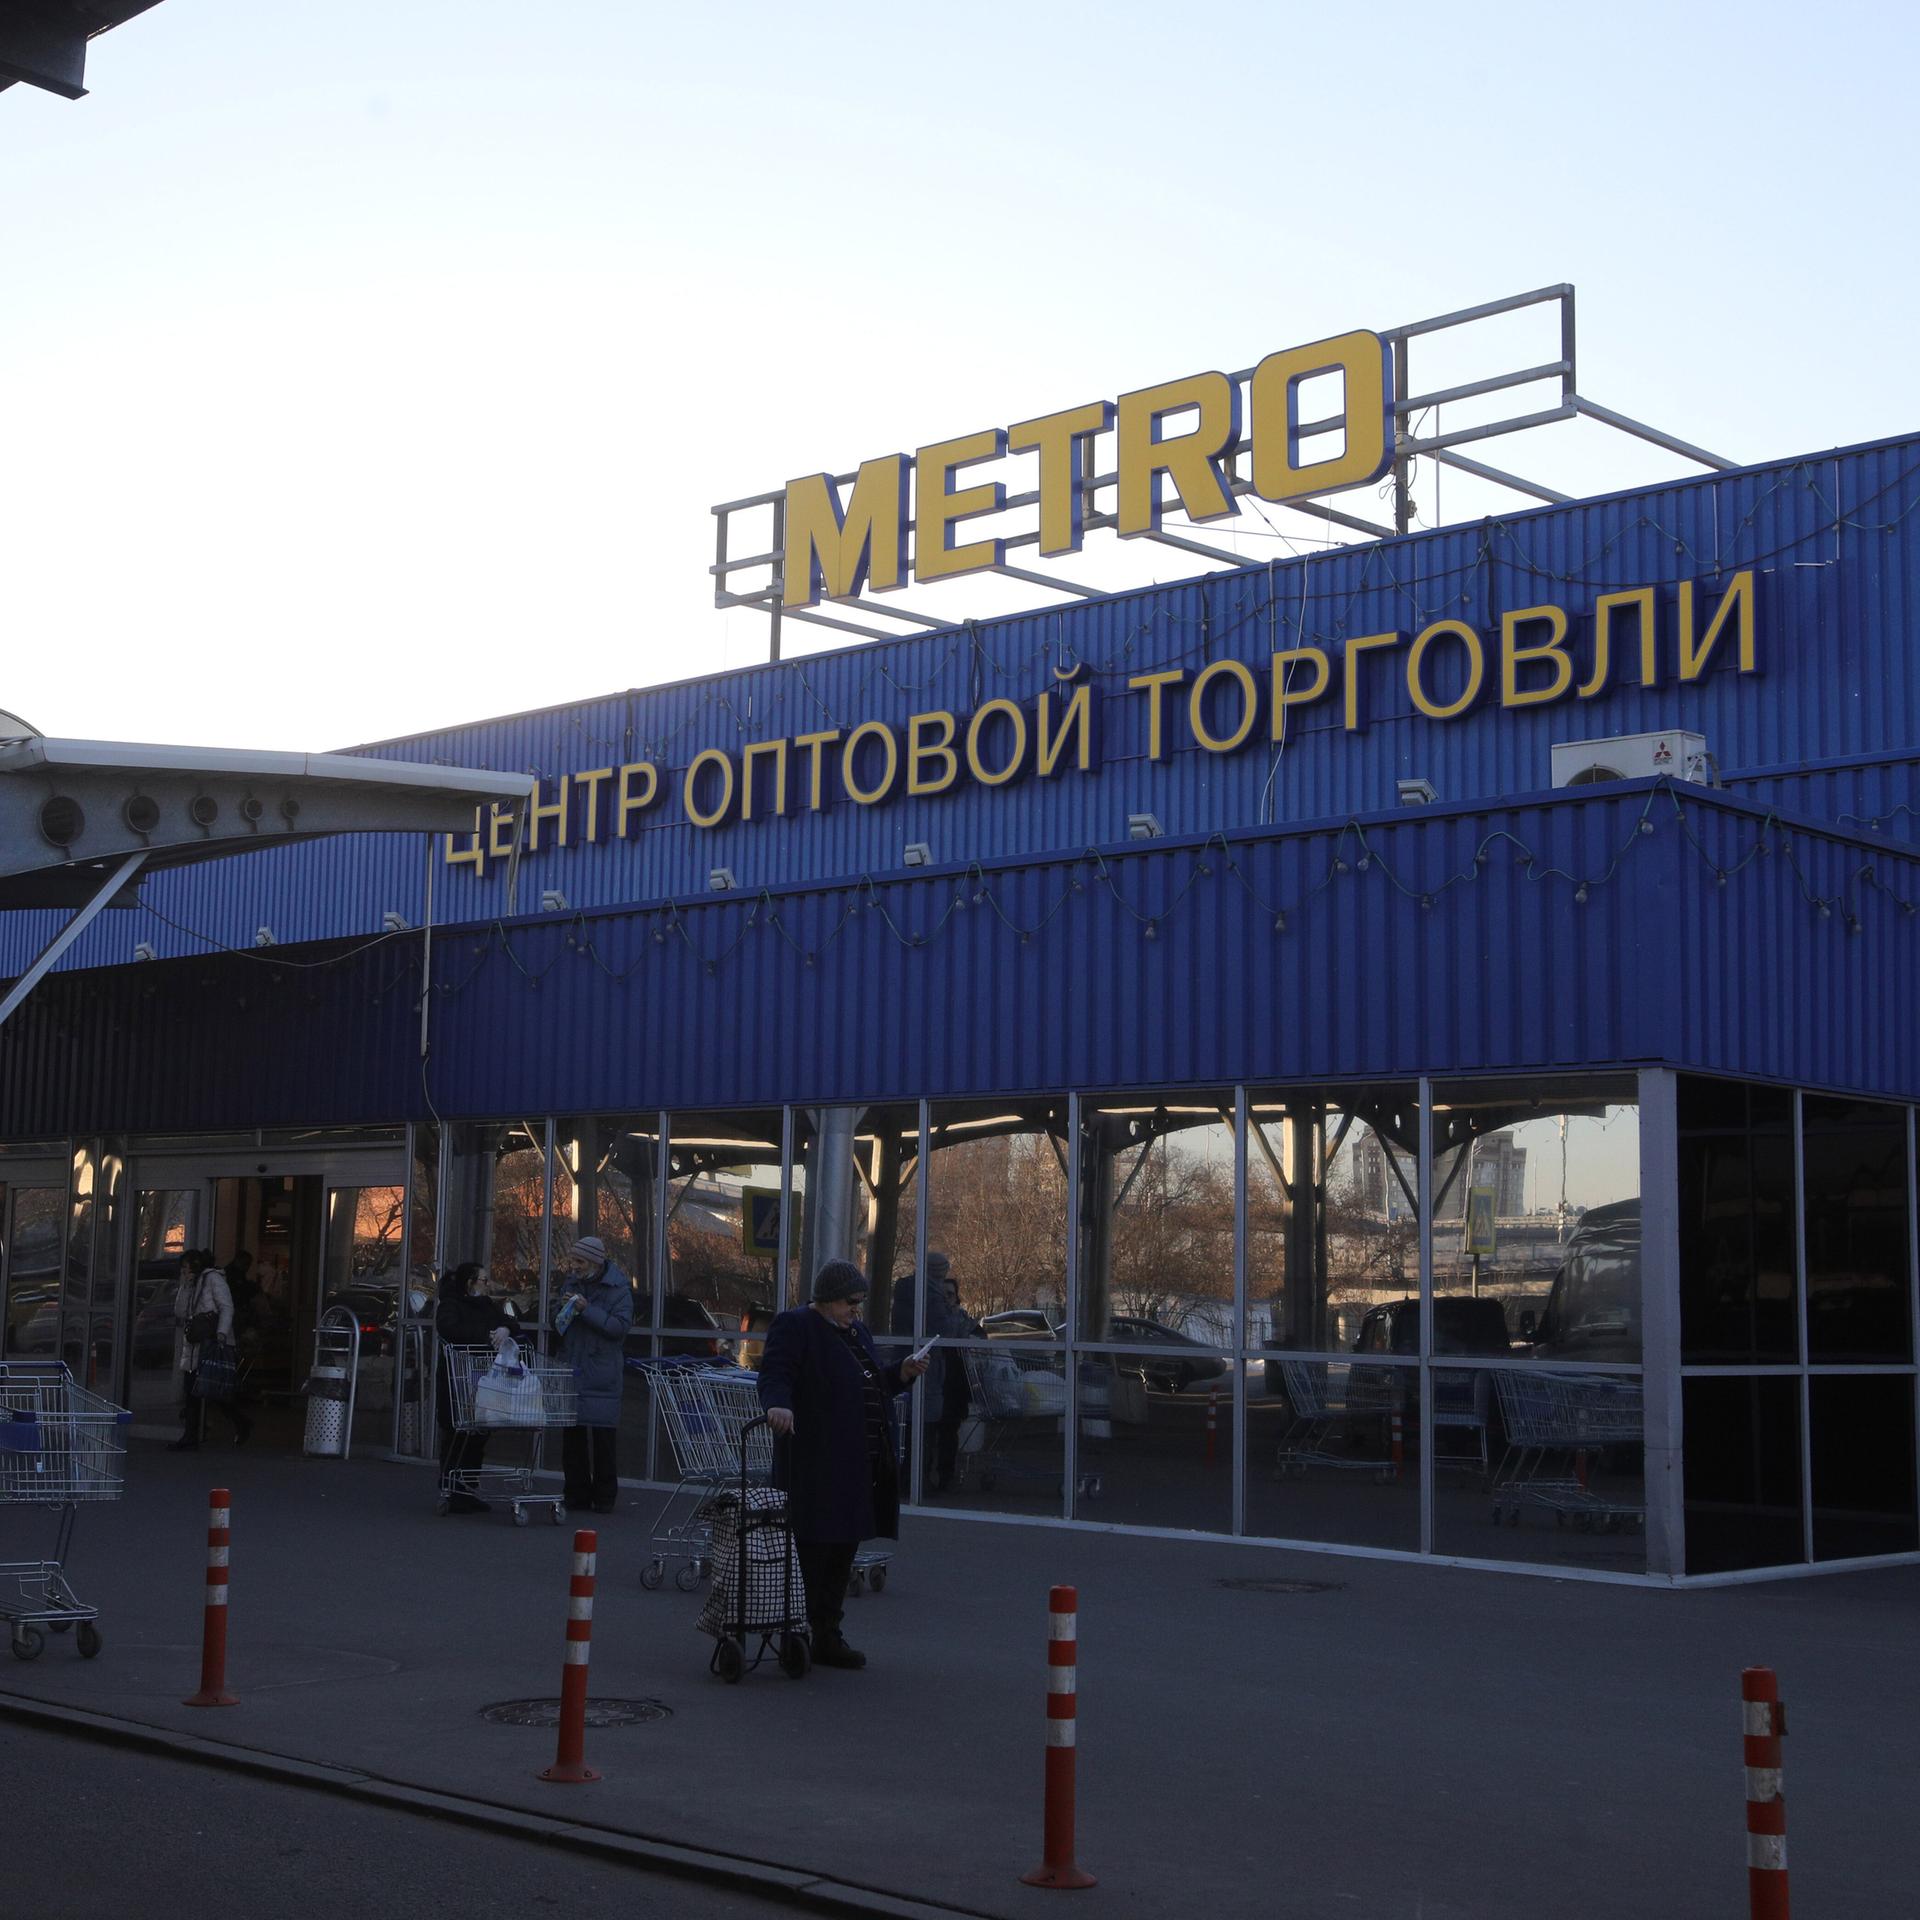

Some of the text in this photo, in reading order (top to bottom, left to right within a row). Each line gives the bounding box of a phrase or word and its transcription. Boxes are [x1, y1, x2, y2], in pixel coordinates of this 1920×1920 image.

[782, 329, 1390, 609] METRO
[445, 568, 1758, 877] ЦЕНТР ОПТОВОЙ ТОРГОВЛИ
